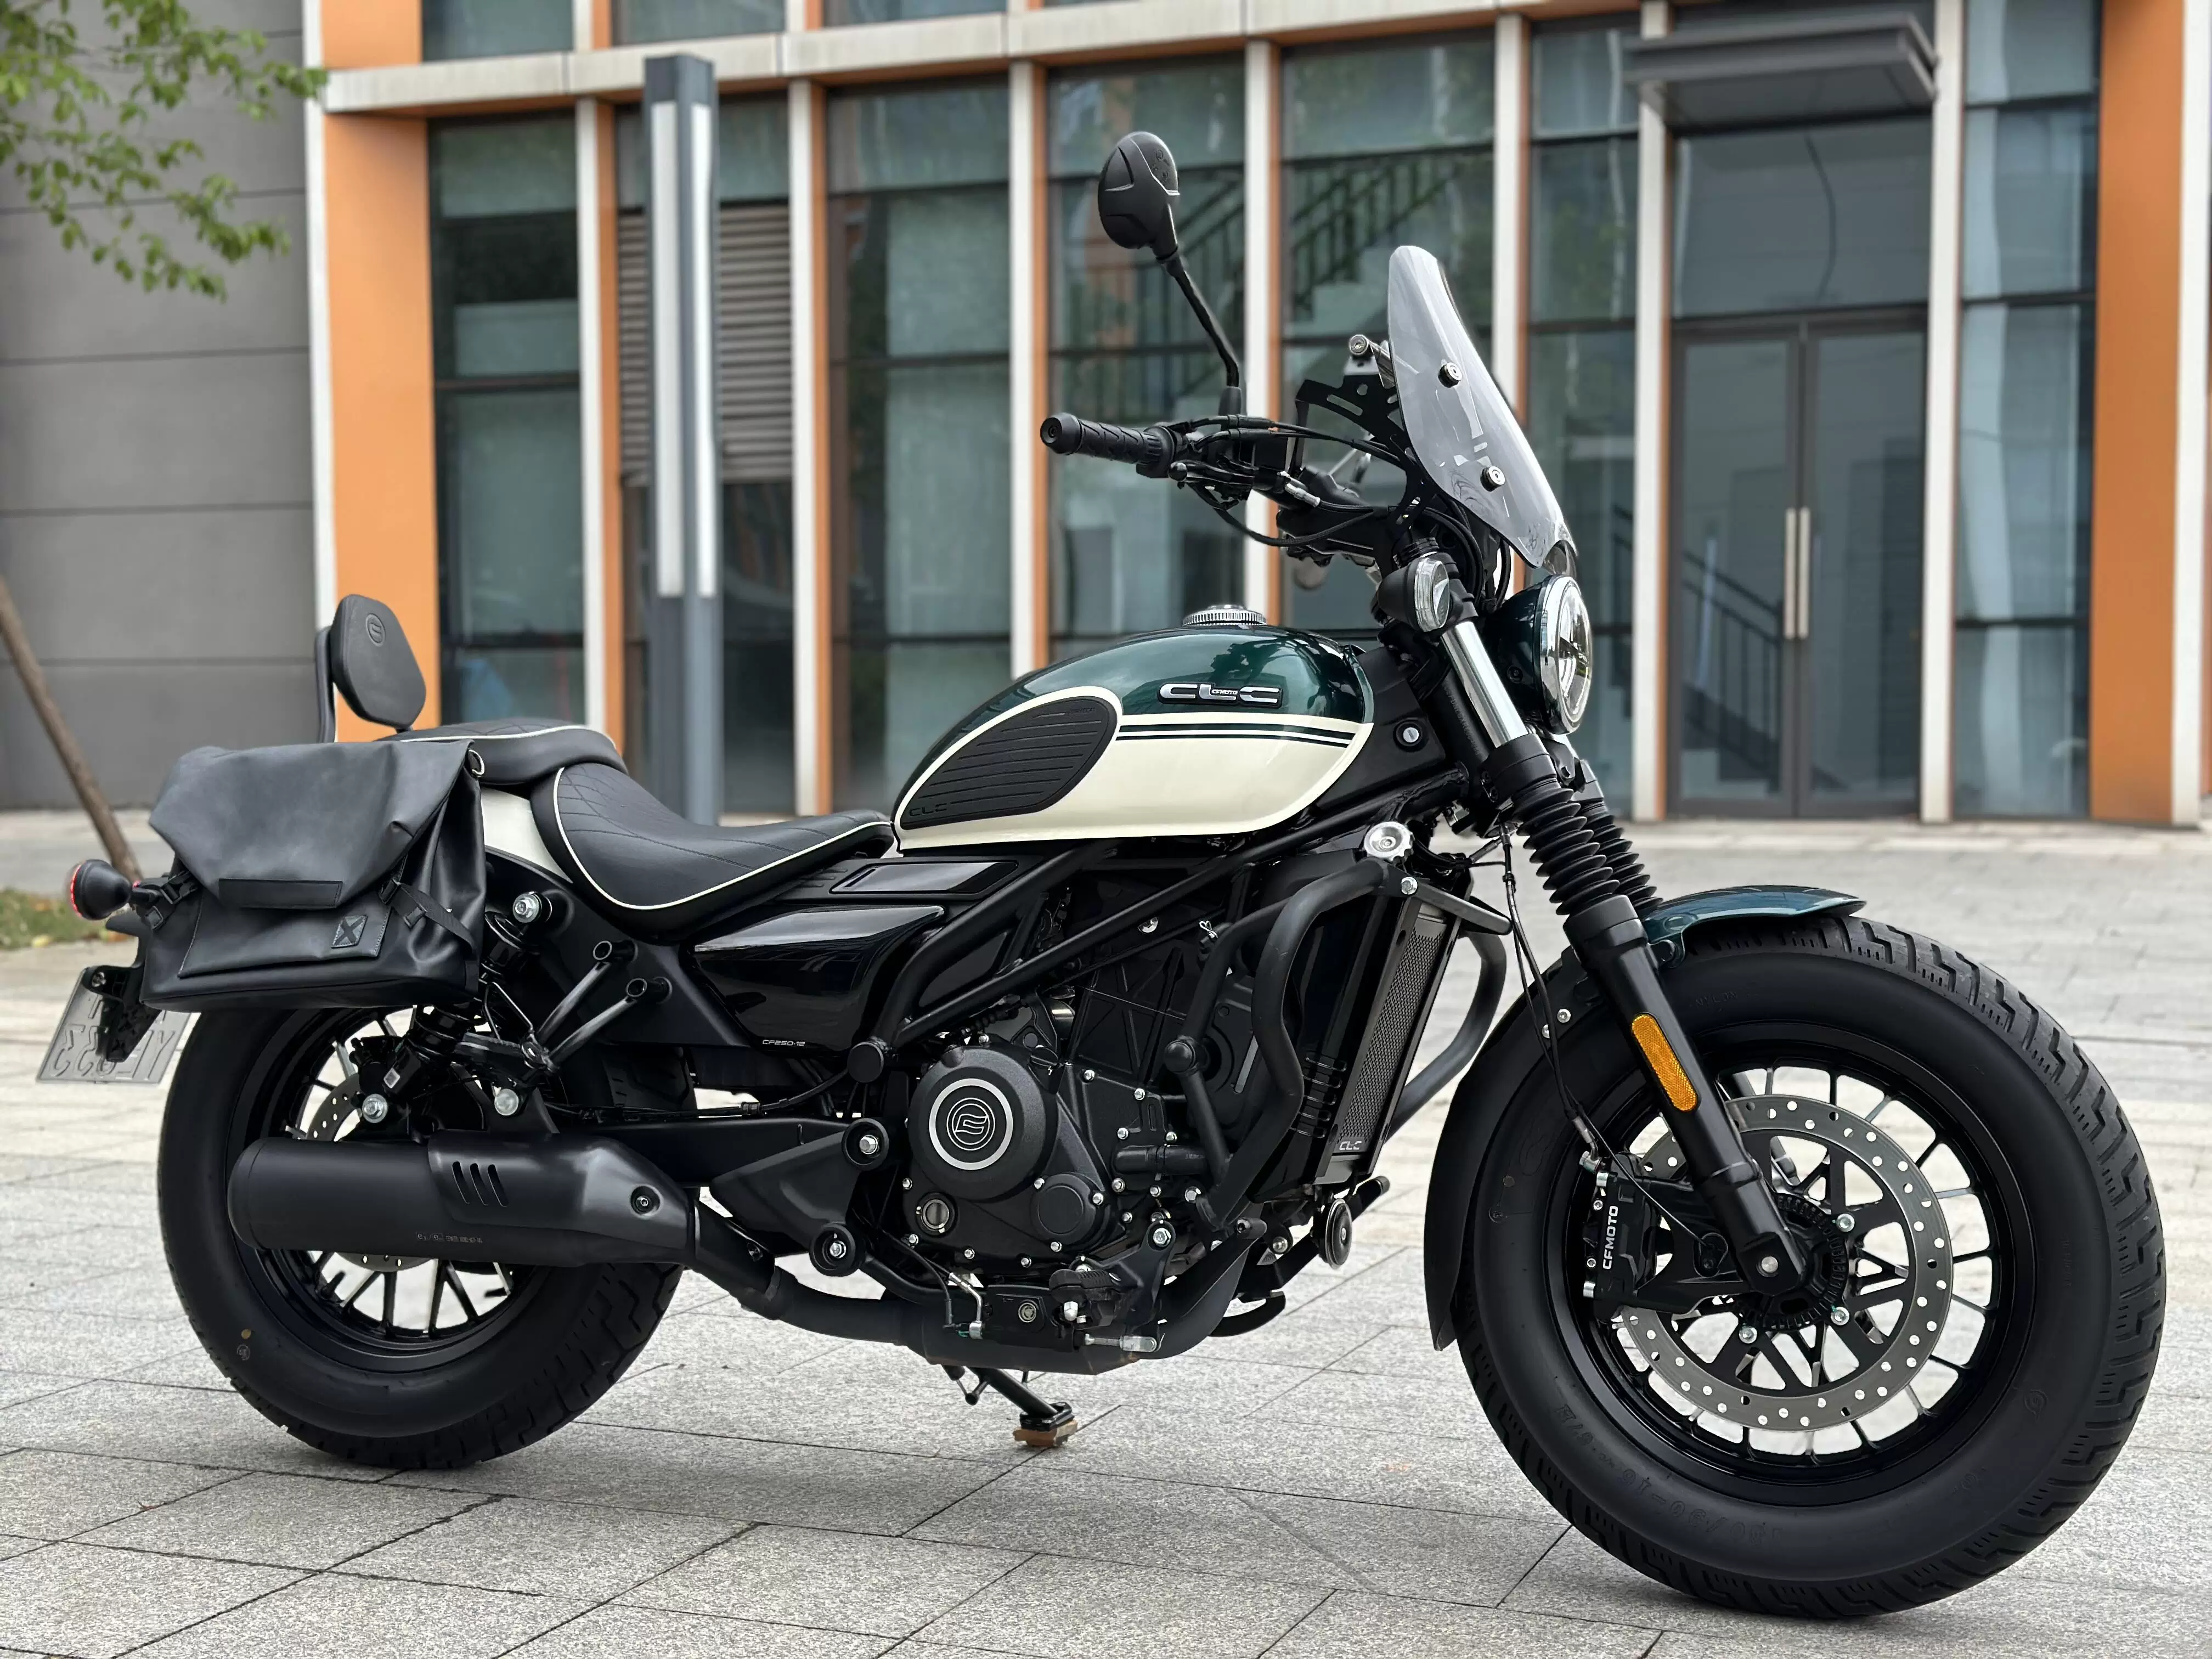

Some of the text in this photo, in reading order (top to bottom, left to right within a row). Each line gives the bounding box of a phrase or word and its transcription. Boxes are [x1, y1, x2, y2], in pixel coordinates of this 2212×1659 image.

[1160, 684, 1280, 704] CLC
[909, 803, 947, 817] CLC
[1339, 1141, 1362, 1150] CLC
[1602, 1206, 1618, 1270] CFMOTO
